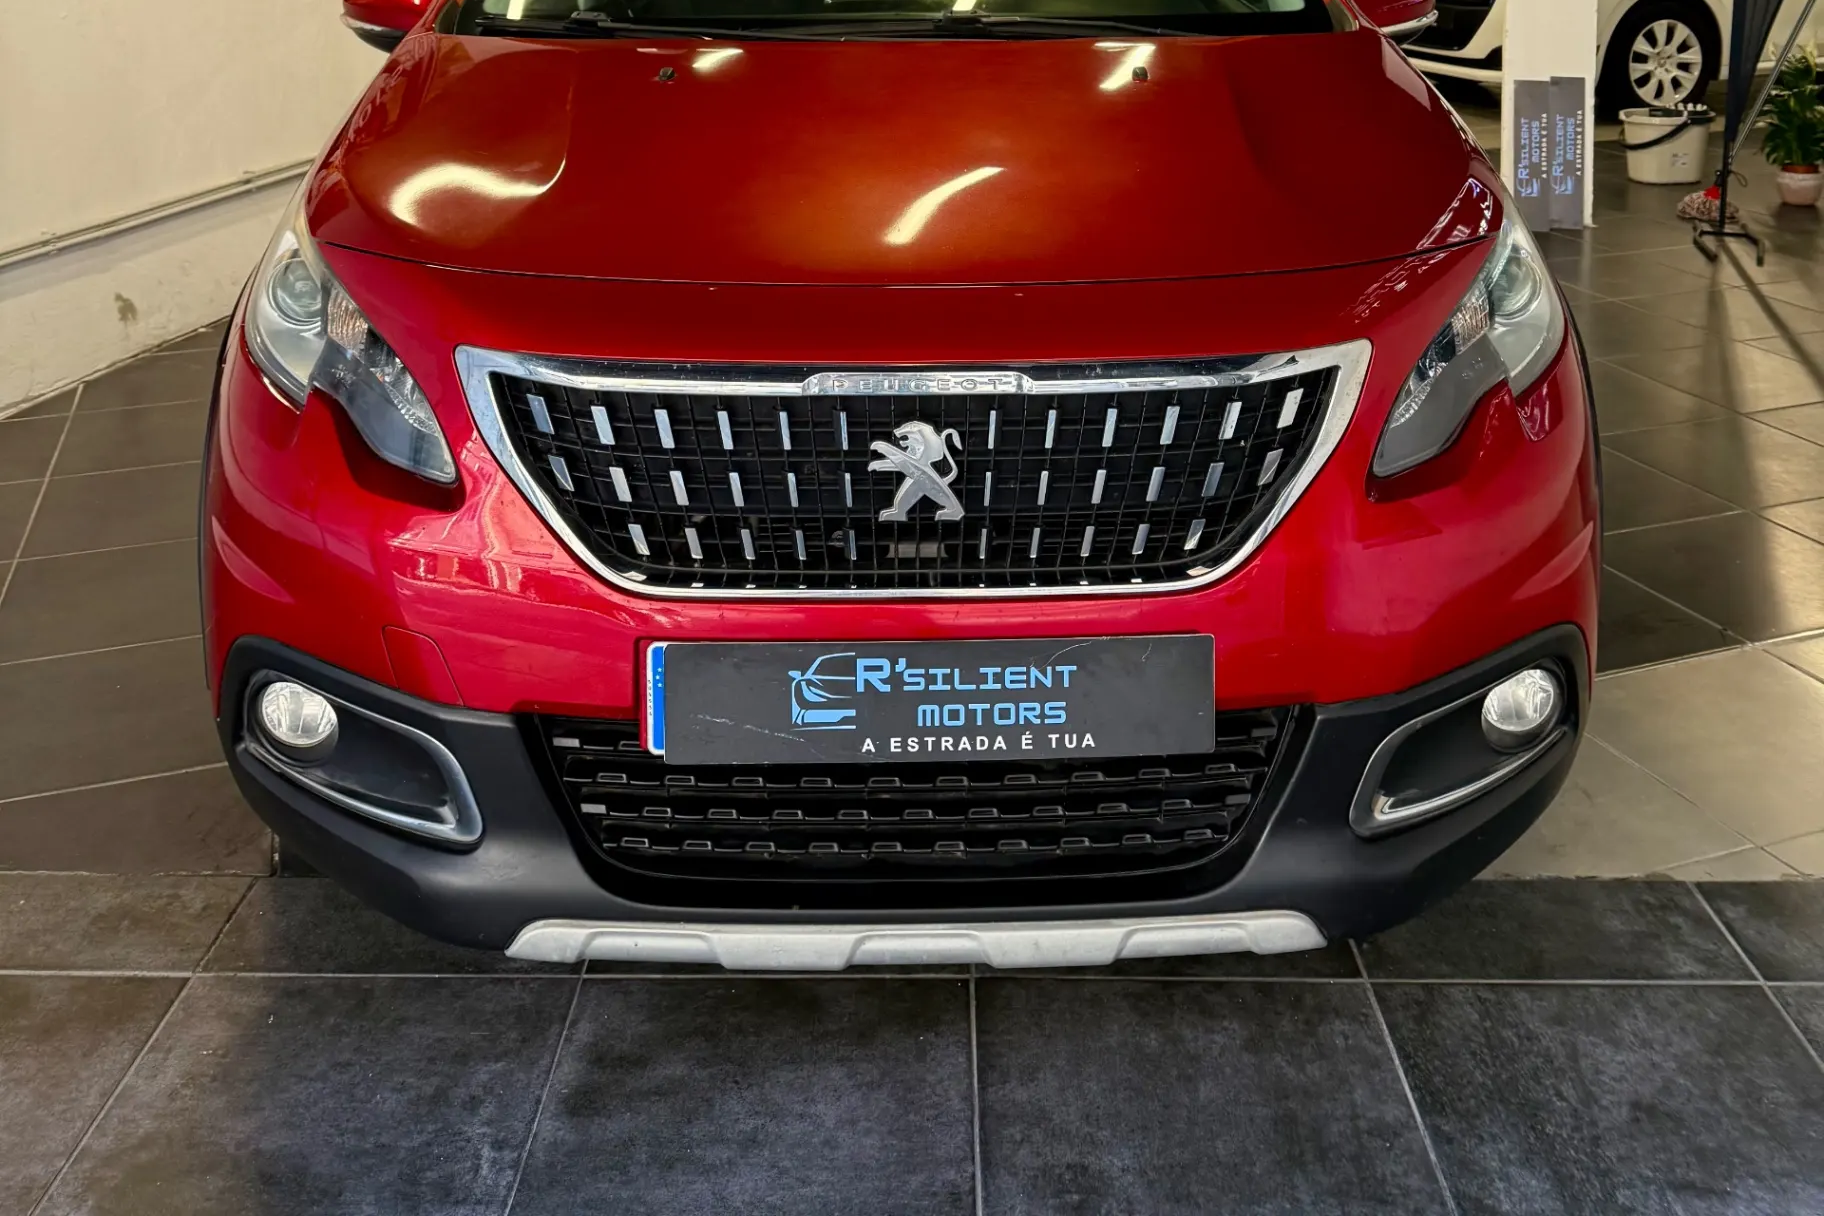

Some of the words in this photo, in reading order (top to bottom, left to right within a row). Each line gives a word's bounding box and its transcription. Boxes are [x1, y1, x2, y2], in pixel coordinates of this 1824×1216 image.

[1531, 120, 1540, 163] MOTORS
[1566, 117, 1575, 160] MOTORS
[831, 378, 1003, 392] PEUGEOT
[856, 657, 1078, 693] R'SILIENT
[917, 701, 1067, 727] MOTORS
[861, 738, 876, 753] A
[890, 735, 1007, 752] ESTRADA
[1021, 731, 1034, 750] É
[1048, 732, 1096, 750] TUA
